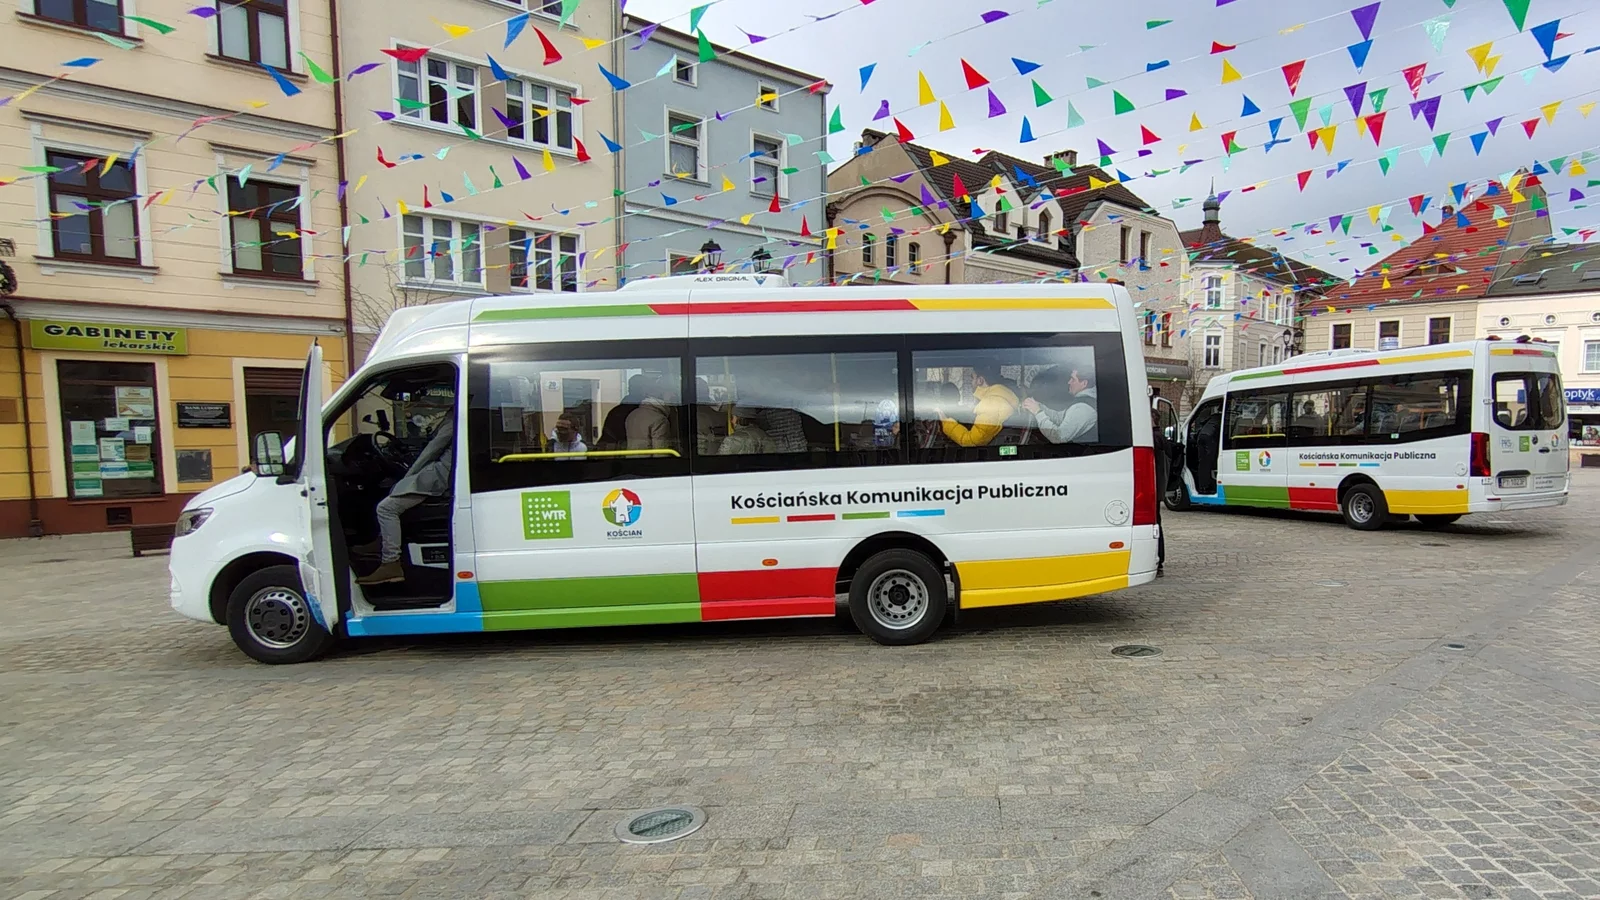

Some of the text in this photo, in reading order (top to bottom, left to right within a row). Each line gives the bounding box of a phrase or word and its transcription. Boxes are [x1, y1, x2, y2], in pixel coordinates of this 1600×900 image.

[44, 324, 177, 341] GABINETY
[103, 340, 176, 351] lekarskie
[1564, 389, 1595, 400] optyk
[1299, 450, 1436, 461] Kościańska Komunikacja Publiczna
[731, 482, 1068, 510] Kościańska Komunikacja Publiczna
[541, 510, 567, 520] WTR
[607, 529, 643, 537] KOŚCIAN
